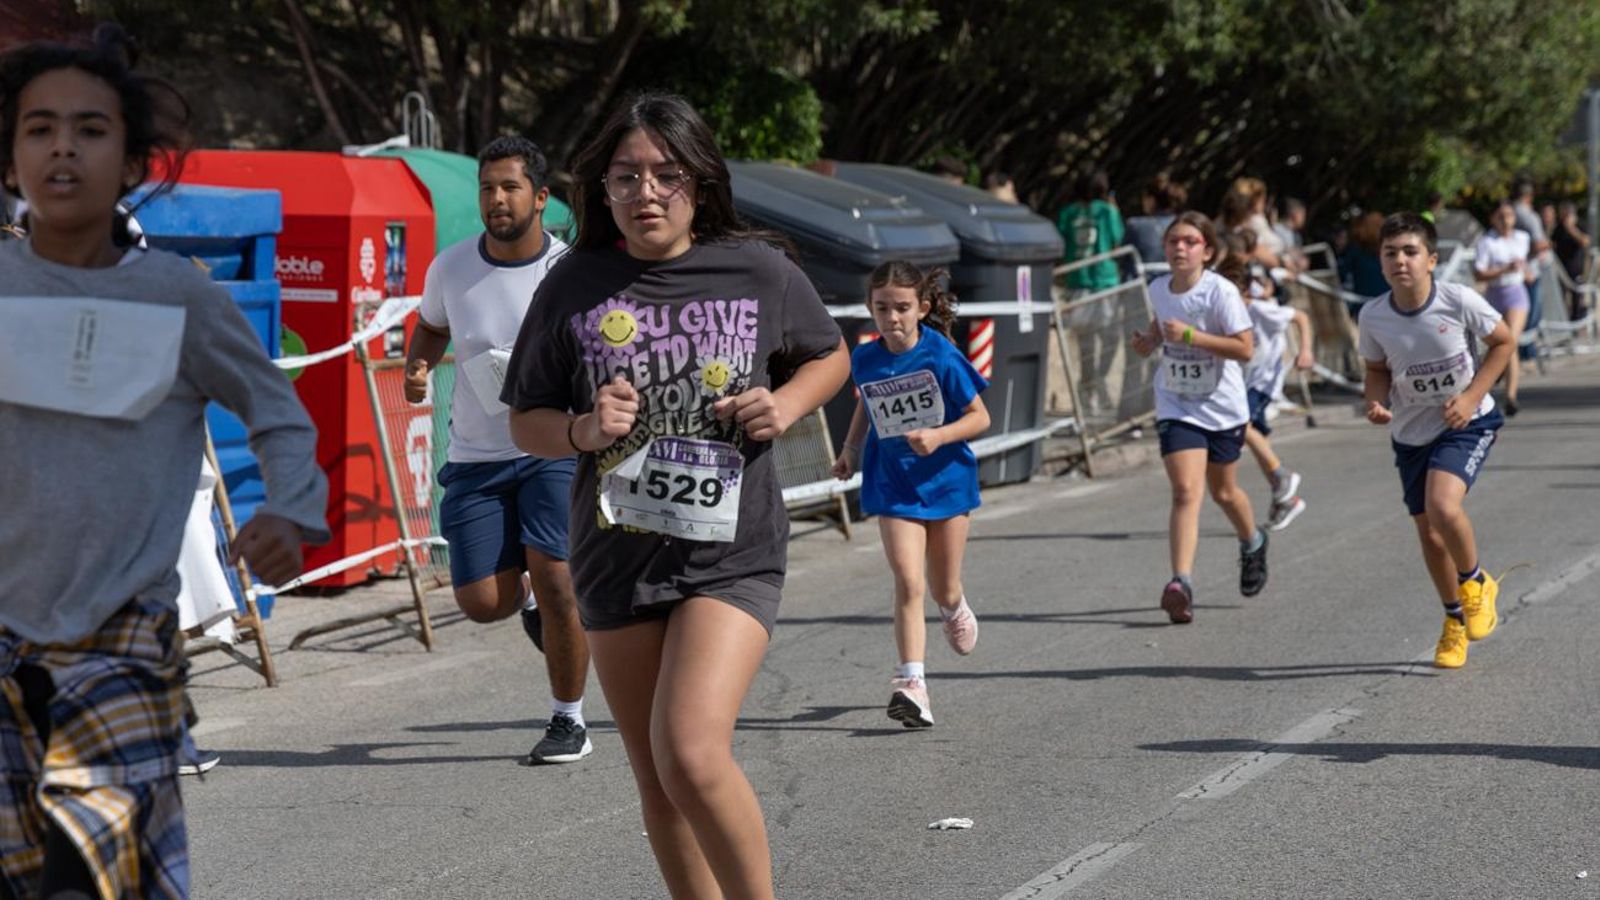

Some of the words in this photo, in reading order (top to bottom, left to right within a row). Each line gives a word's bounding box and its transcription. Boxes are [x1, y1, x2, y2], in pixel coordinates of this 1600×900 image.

[679, 298, 758, 340] GIVE
[650, 334, 690, 382] TO
[692, 330, 757, 376] WHAT
[1170, 363, 1201, 379] 113
[645, 379, 703, 416] YOU
[1413, 373, 1456, 393] 614
[878, 389, 934, 419] 1415
[648, 410, 704, 437] GIVE
